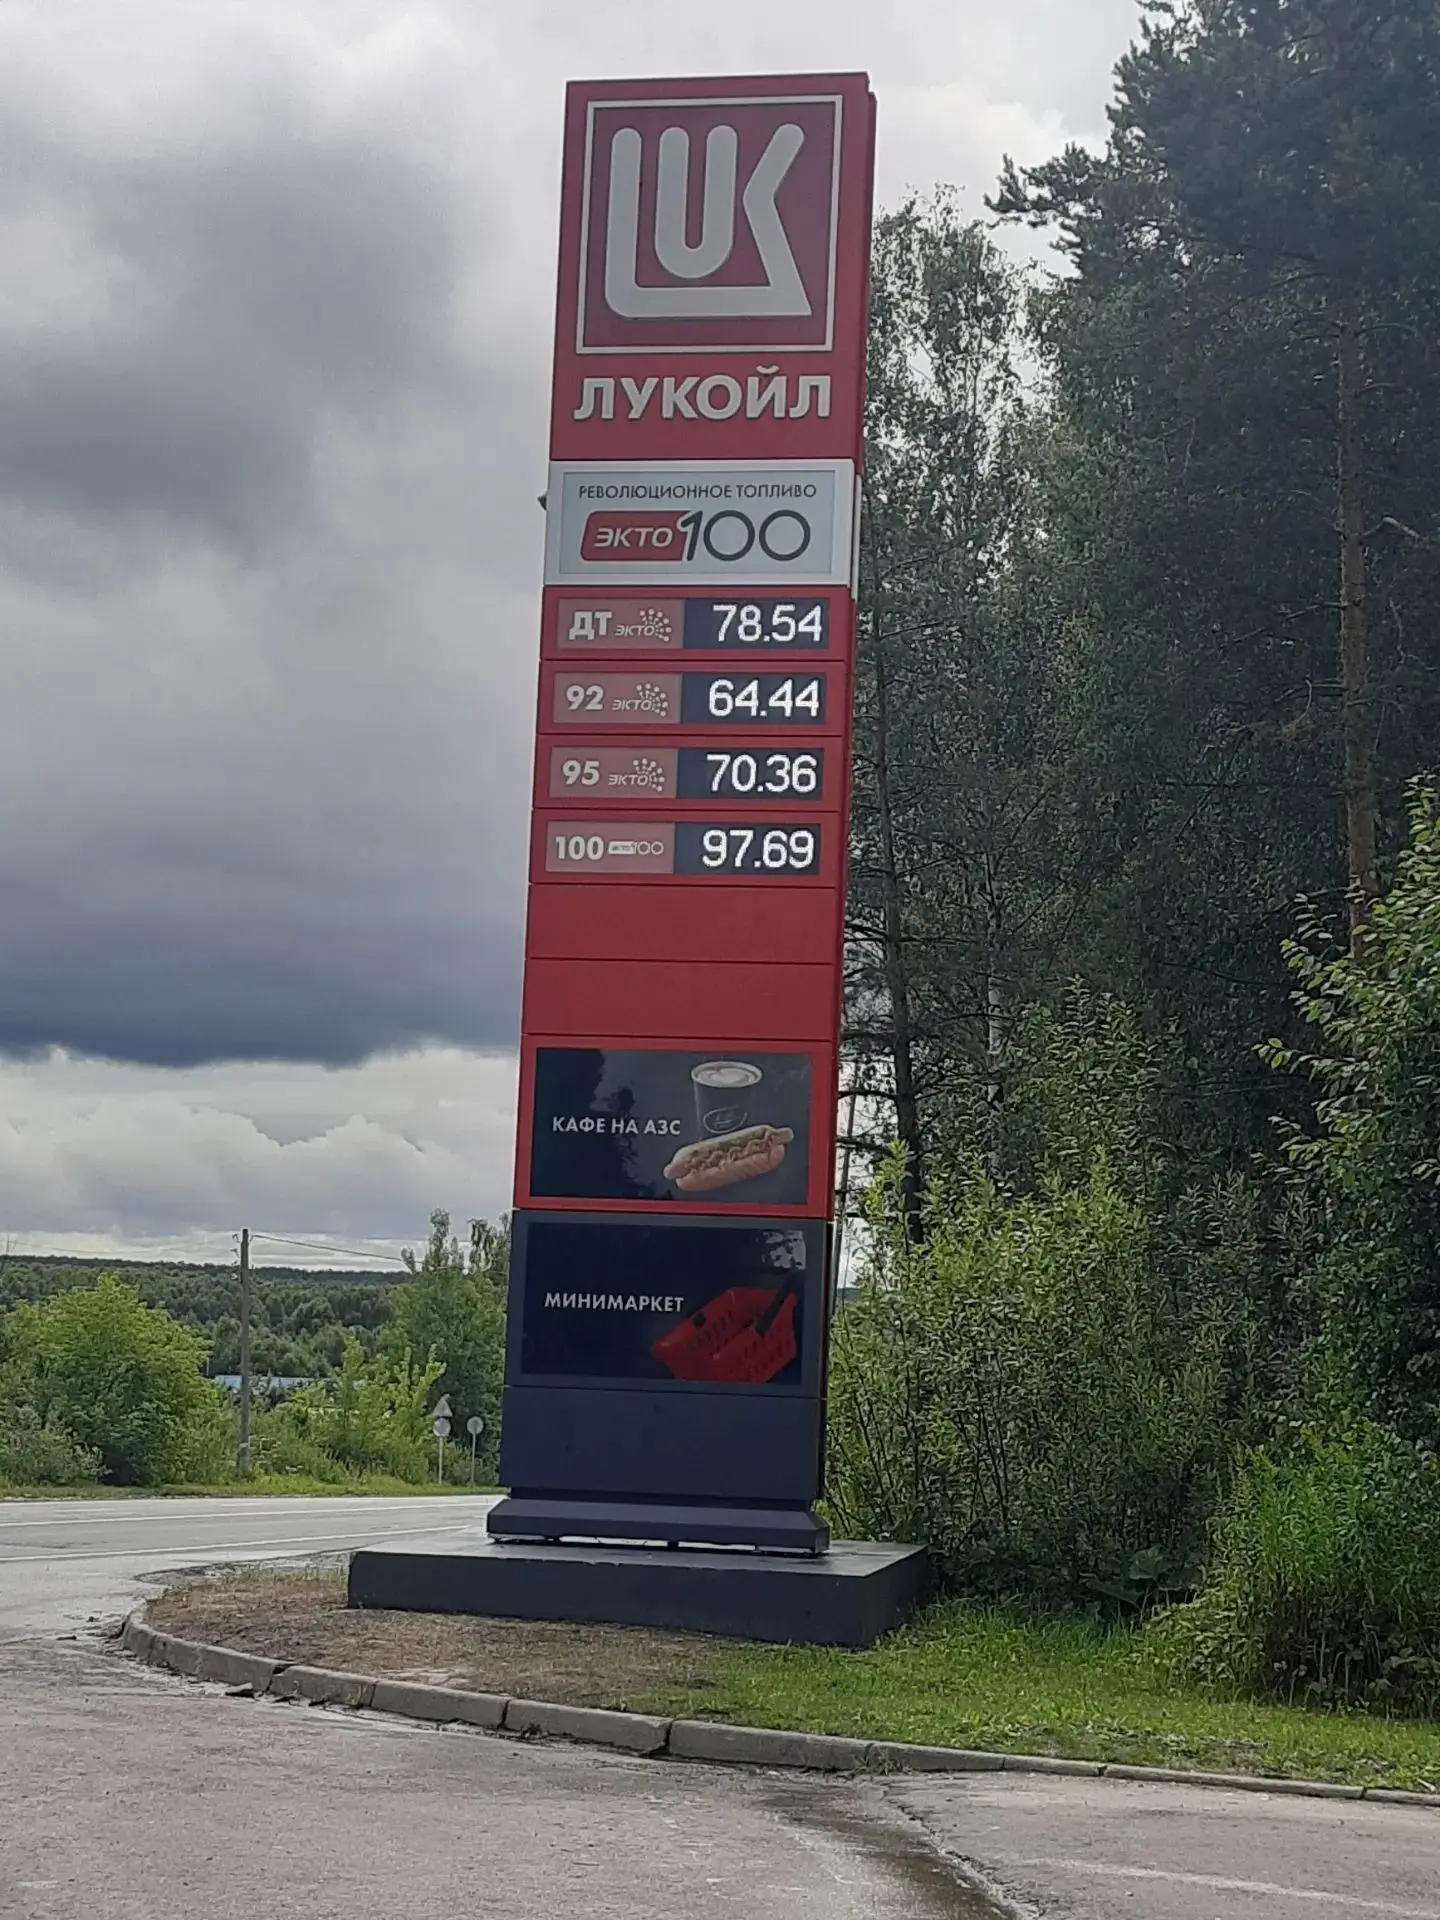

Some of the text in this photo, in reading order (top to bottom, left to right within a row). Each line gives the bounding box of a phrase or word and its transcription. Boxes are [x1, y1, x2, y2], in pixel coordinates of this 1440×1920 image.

[573, 365, 831, 420] ЛУКОЙЛ
[579, 484, 817, 500] РЕВОЛЮЦИОННОЕ ТОПЛИВО
[594, 510, 811, 562] ЭКТО 100
[568, 611, 655, 640] ДТ ЭКТО
[713, 604, 822, 642] 78.54
[566, 685, 651, 712] 92 ЭКТО
[708, 679, 819, 717] 64.44
[562, 759, 648, 787] 95 ЭКТО
[706, 754, 817, 792] 70.36
[555, 836, 604, 861] 100
[702, 829, 814, 868] 97.69
[552, 1116, 681, 1136] КАФЕ НА АЗС
[544, 1292, 684, 1313] МИНИМАРКЕТ
